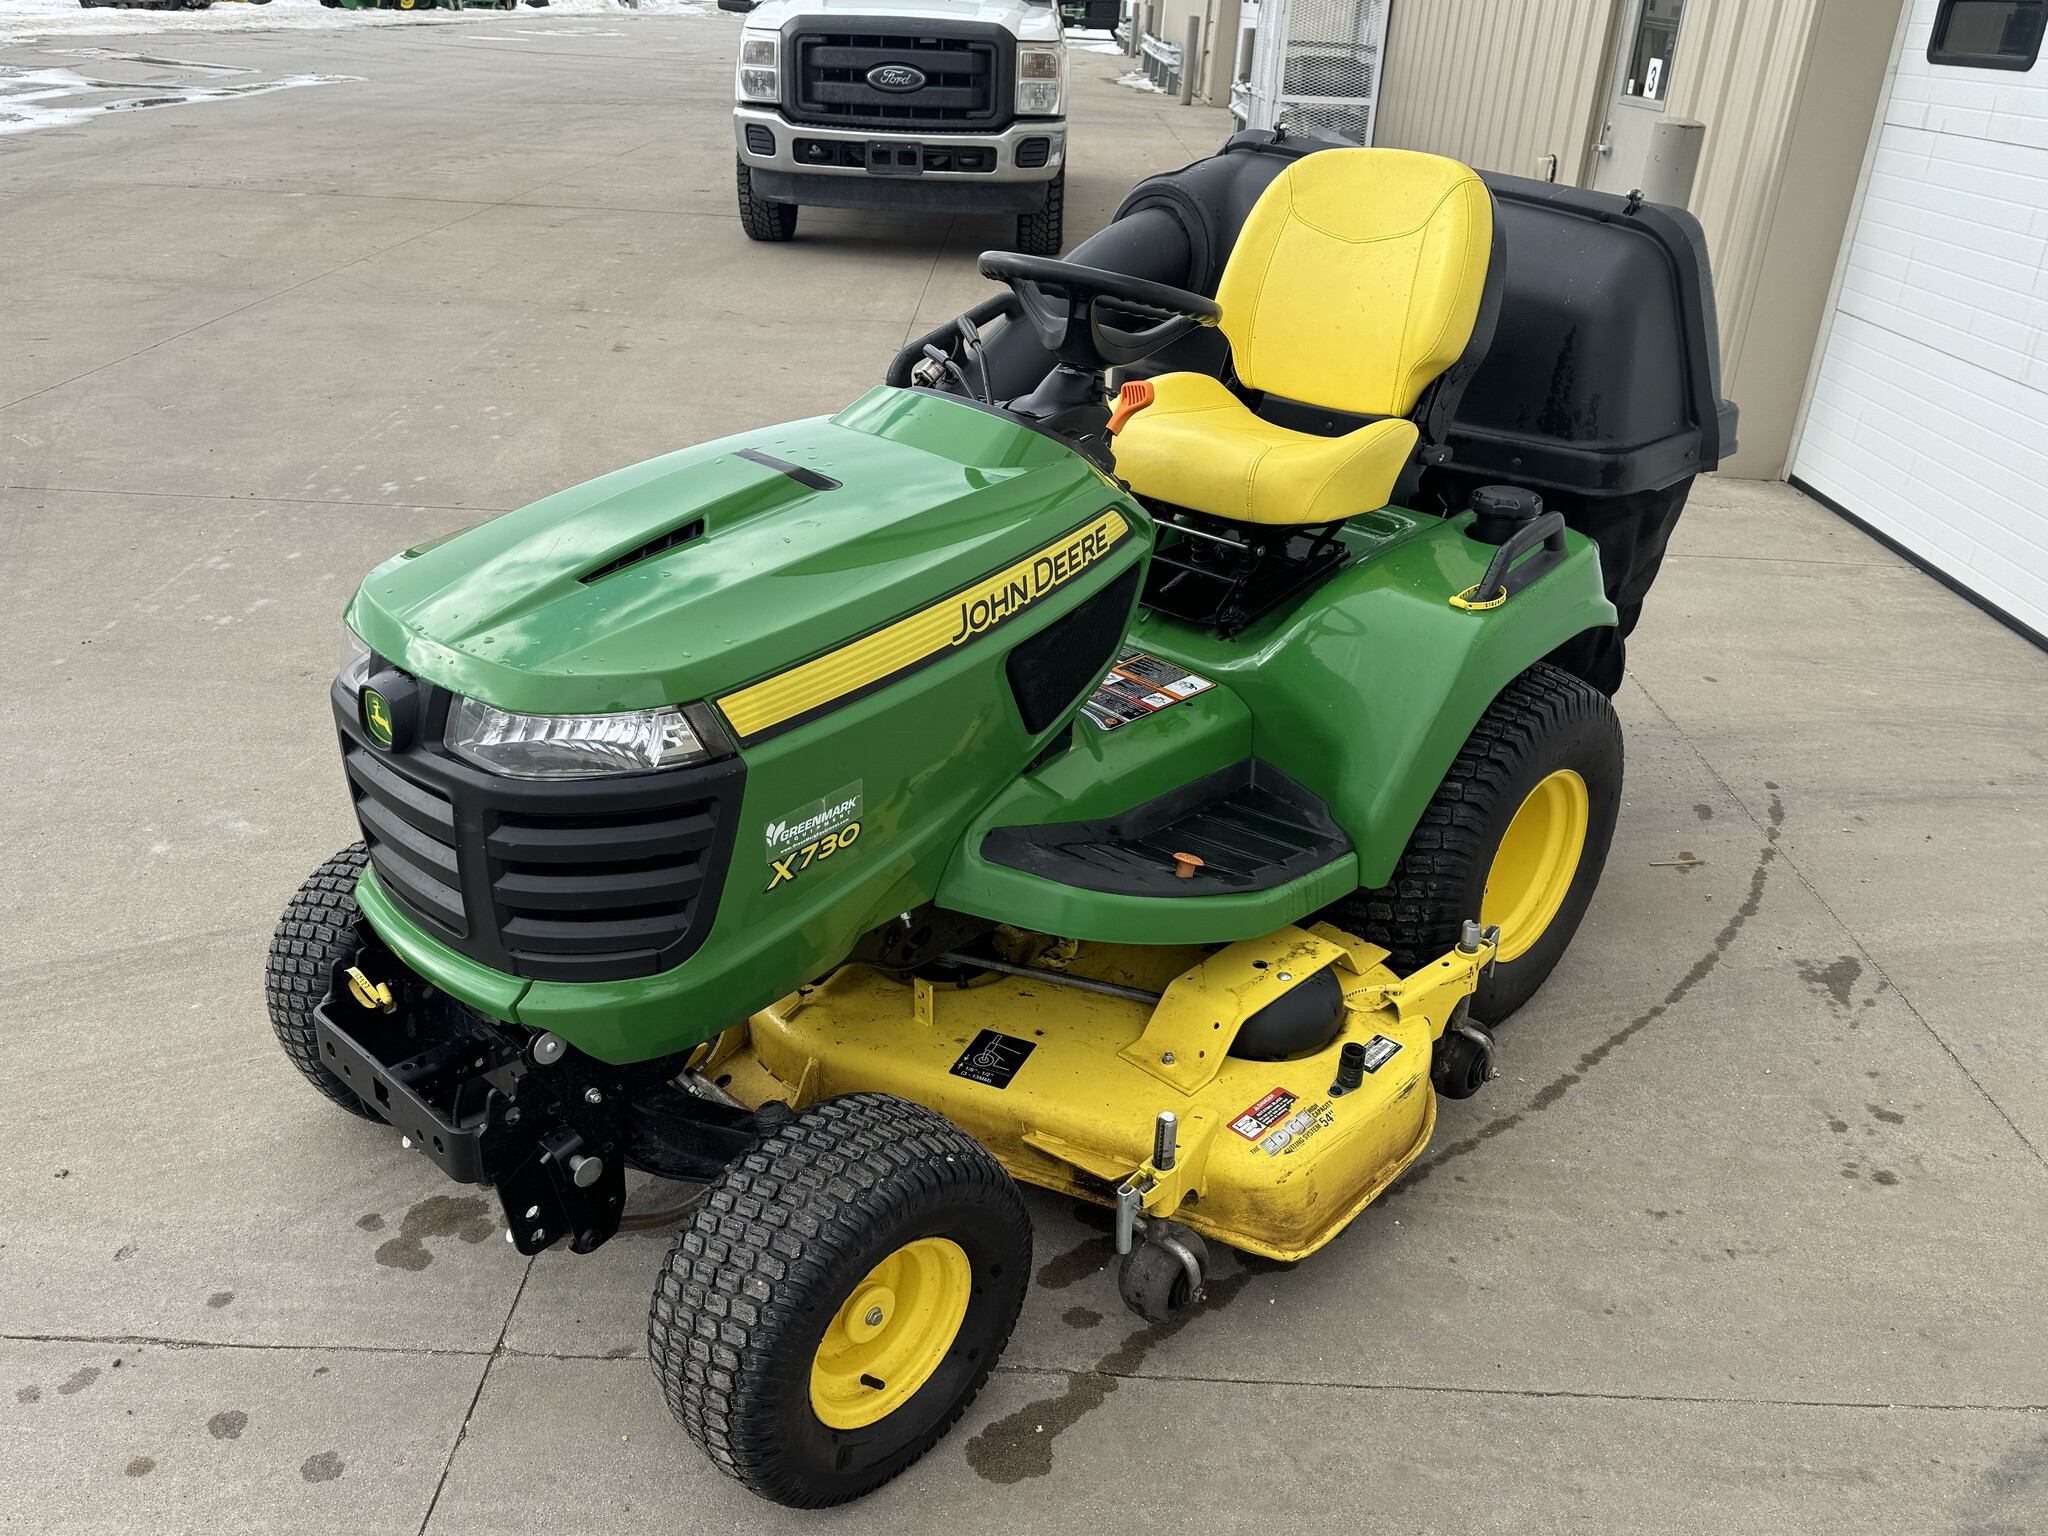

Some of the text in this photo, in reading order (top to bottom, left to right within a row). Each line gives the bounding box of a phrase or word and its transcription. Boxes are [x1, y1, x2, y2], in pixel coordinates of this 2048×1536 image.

[880, 69, 912, 85] Ford
[1648, 66, 1657, 92] 3
[952, 523, 1109, 644] JOHN DEERE
[780, 796, 858, 842] GREENMARK
[786, 809, 851, 844] EQUIPMENT
[763, 822, 861, 893] X730
[1303, 1123, 1321, 1141] SYSTEM
[1319, 1109, 1335, 1128] 54"
[1311, 1100, 1334, 1119] CAPACITY
[1250, 1145, 1261, 1155] THE
[1260, 1109, 1317, 1157] EDGE
